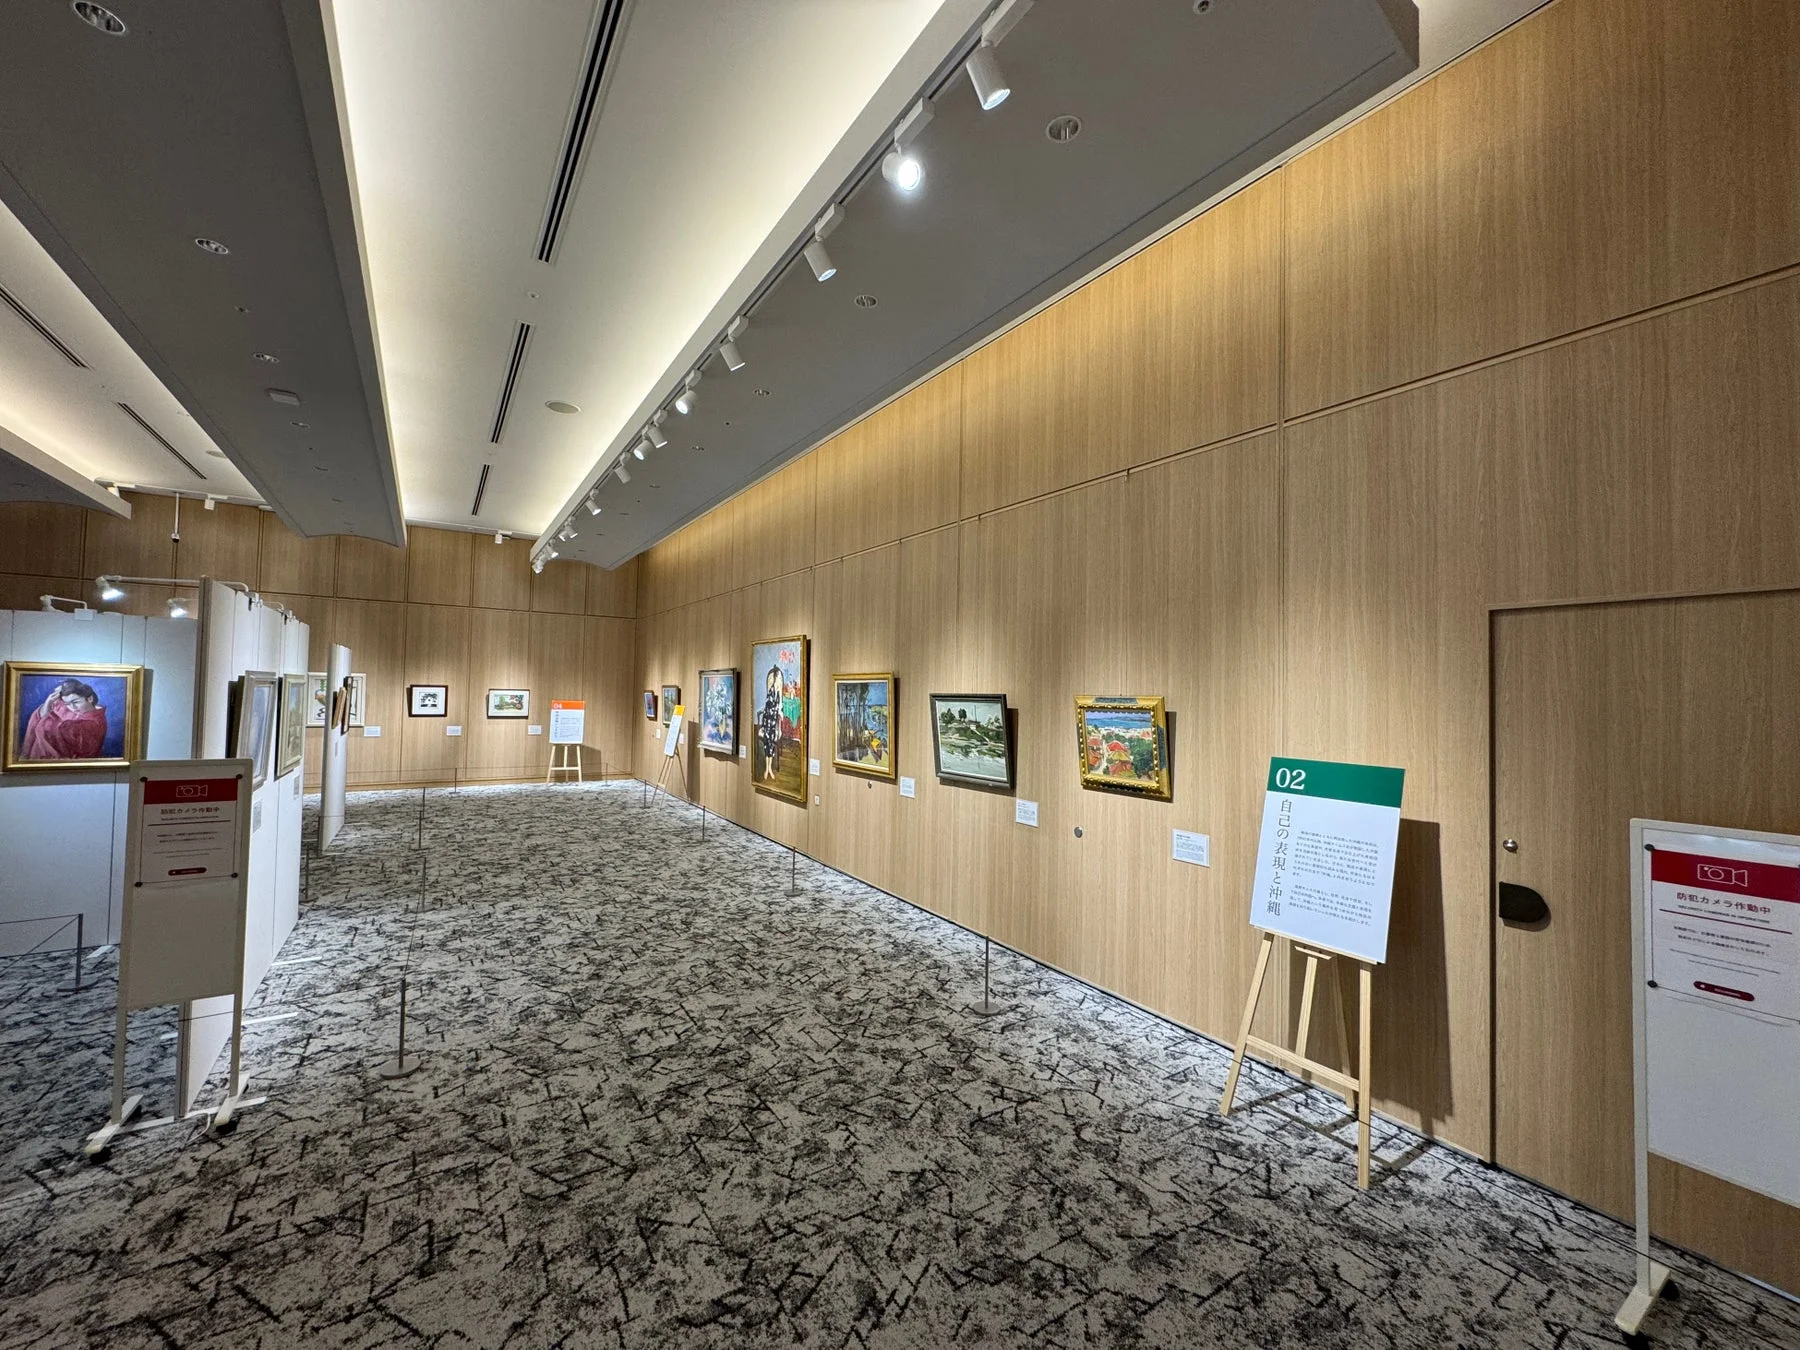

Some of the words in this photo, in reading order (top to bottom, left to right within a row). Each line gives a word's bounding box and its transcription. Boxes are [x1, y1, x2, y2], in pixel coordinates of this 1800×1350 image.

[1275, 767, 1306, 790] 02
[1266, 799, 1292, 917] 自己の表現と沖縄
[1676, 892, 1771, 914] 防犯カメラ作動中
